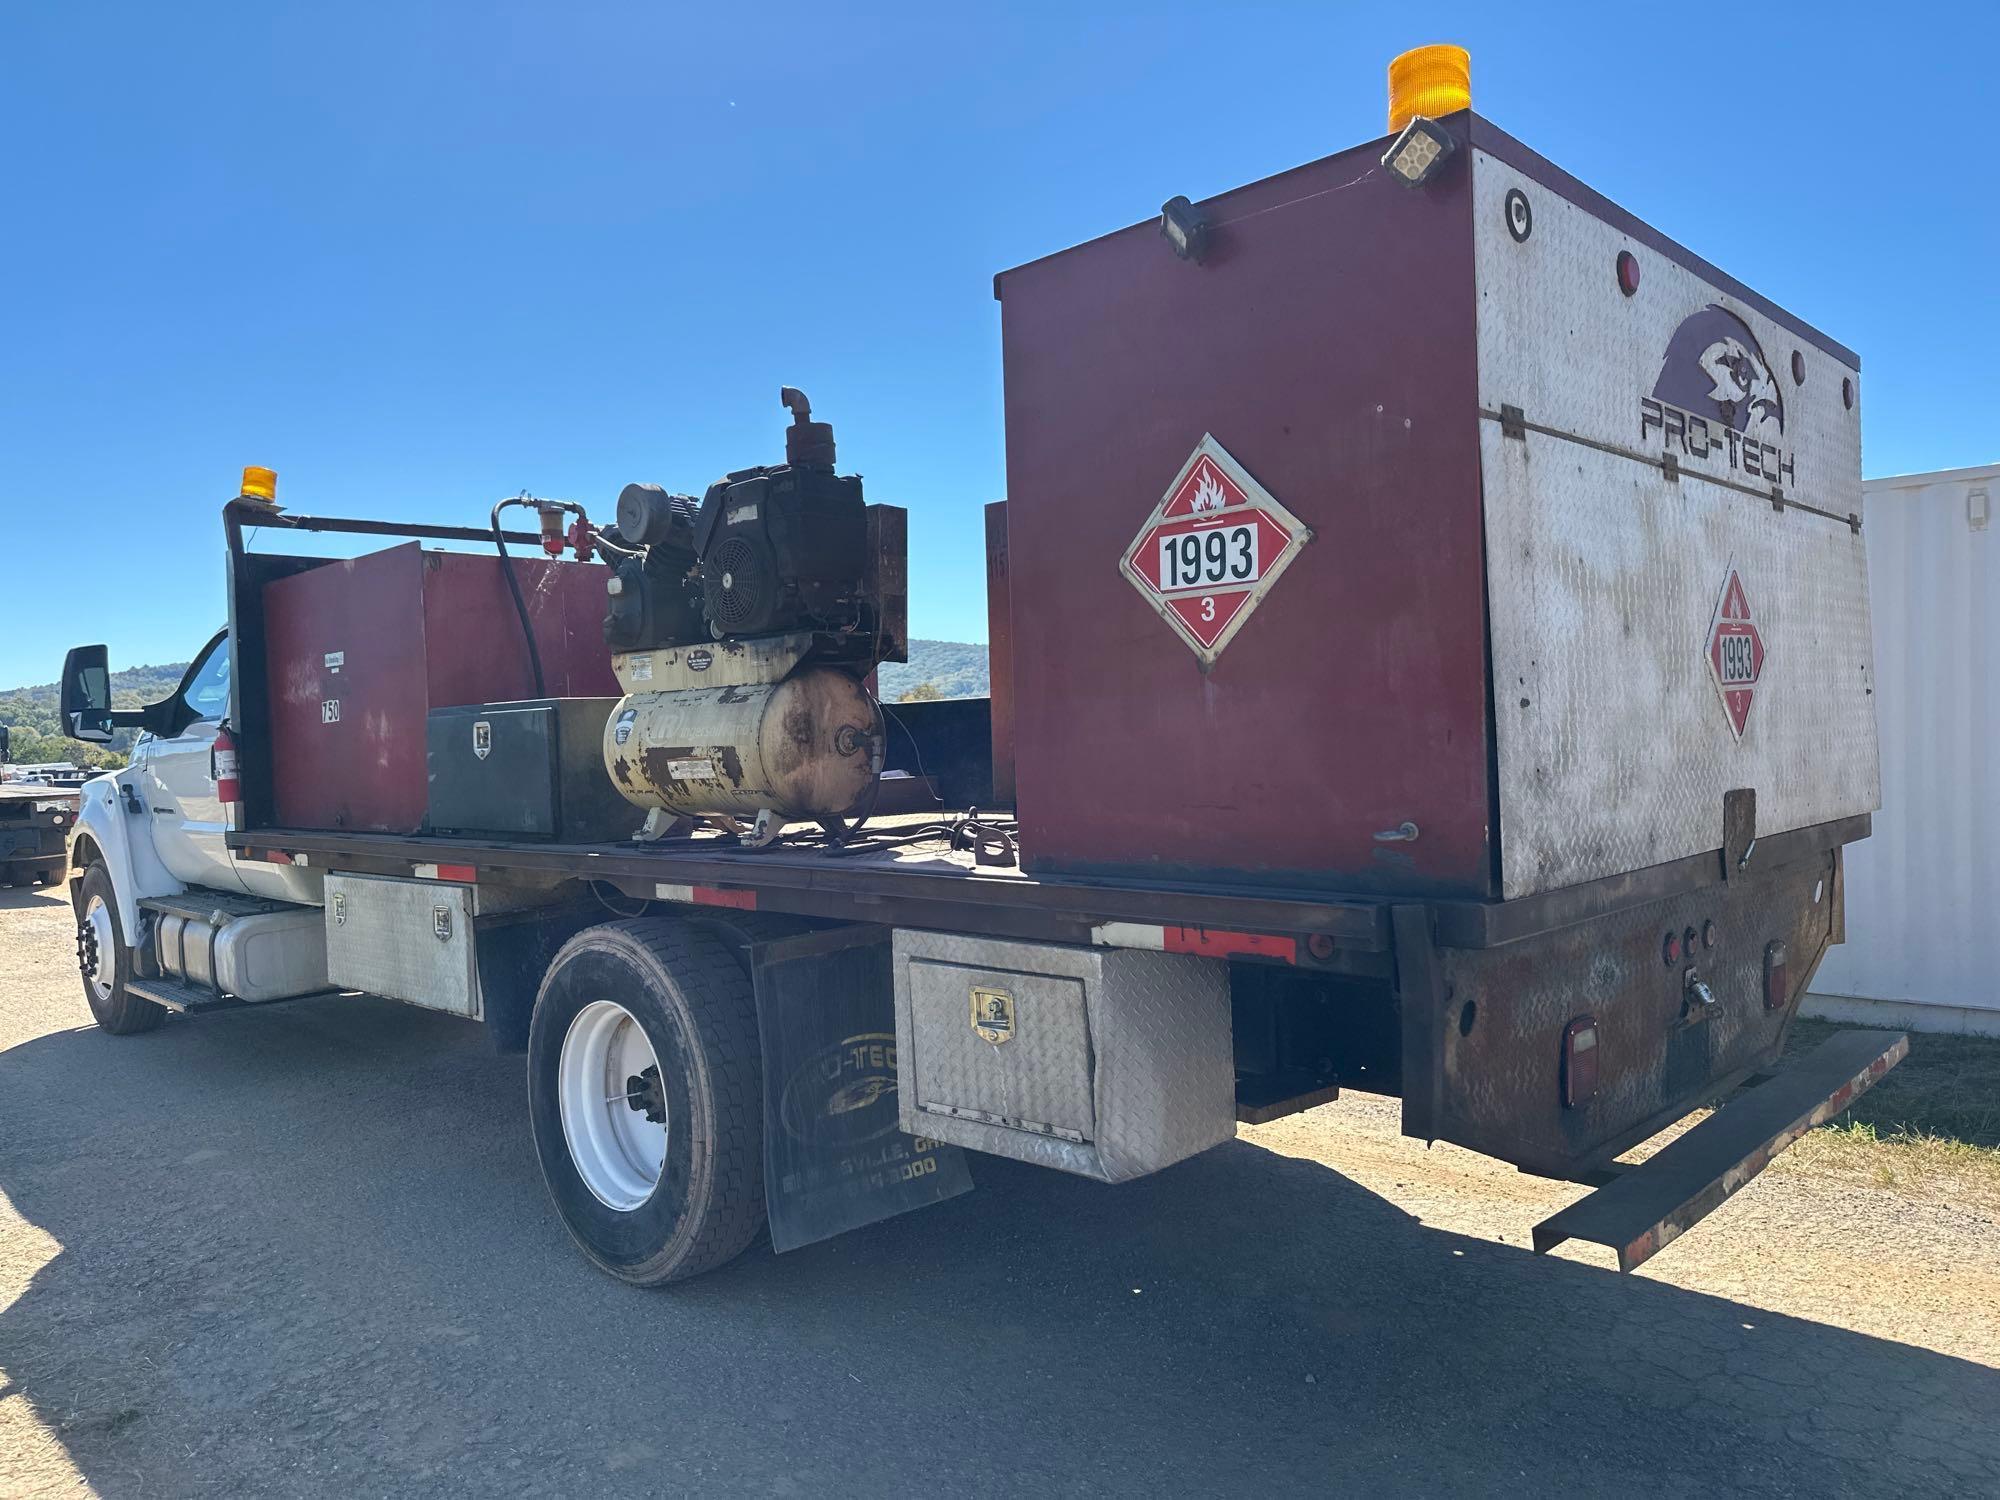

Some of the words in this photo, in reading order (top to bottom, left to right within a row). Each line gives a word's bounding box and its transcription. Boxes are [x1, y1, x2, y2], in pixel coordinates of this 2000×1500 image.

[1641, 397, 1795, 489] PRO-TECH
[1164, 527, 1253, 587] 1993
[1200, 596, 1216, 622] 3
[1722, 636, 1753, 680] 1993
[322, 700, 339, 723] 750
[1735, 691, 1742, 713] 3
